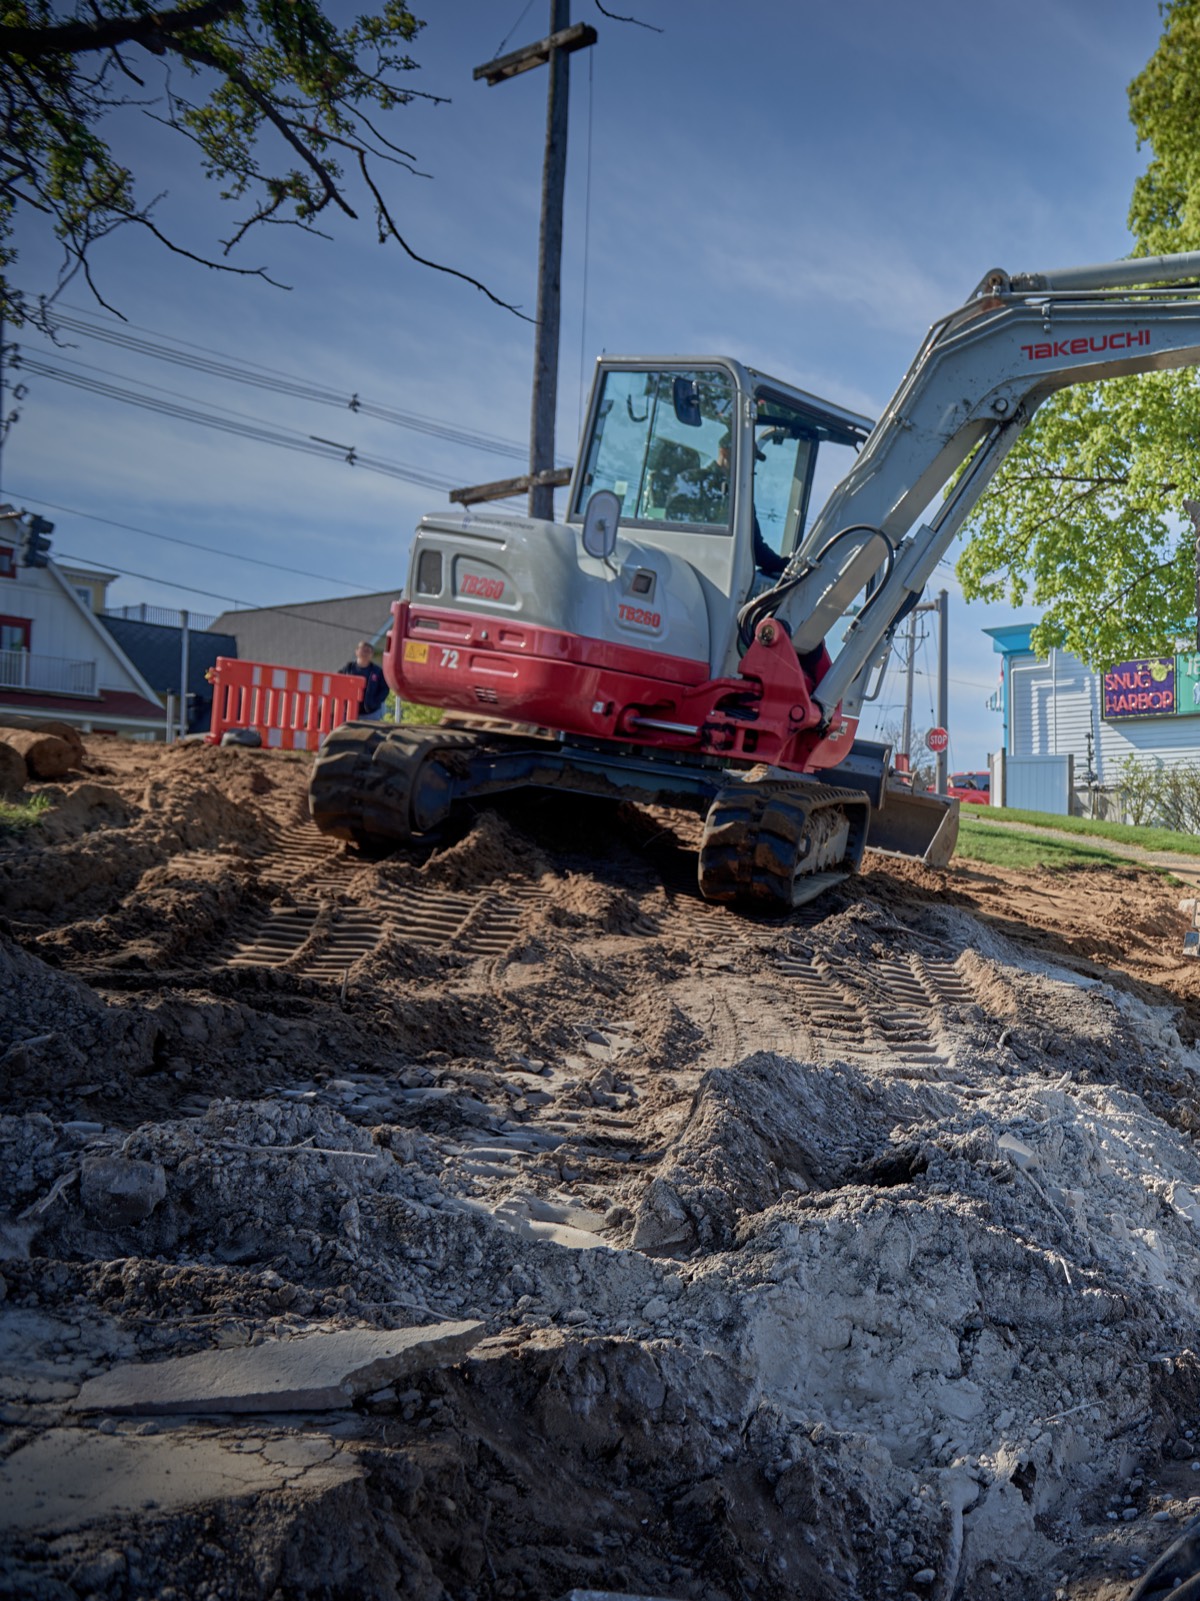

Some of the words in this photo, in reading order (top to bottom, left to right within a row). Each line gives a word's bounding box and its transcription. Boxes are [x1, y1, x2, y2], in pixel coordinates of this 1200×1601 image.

[460, 573, 504, 600] TB260
[618, 603, 661, 628] TB260
[439, 648, 459, 669] 72
[1104, 671, 1151, 691] SNUG
[930, 734, 948, 745] STOP
